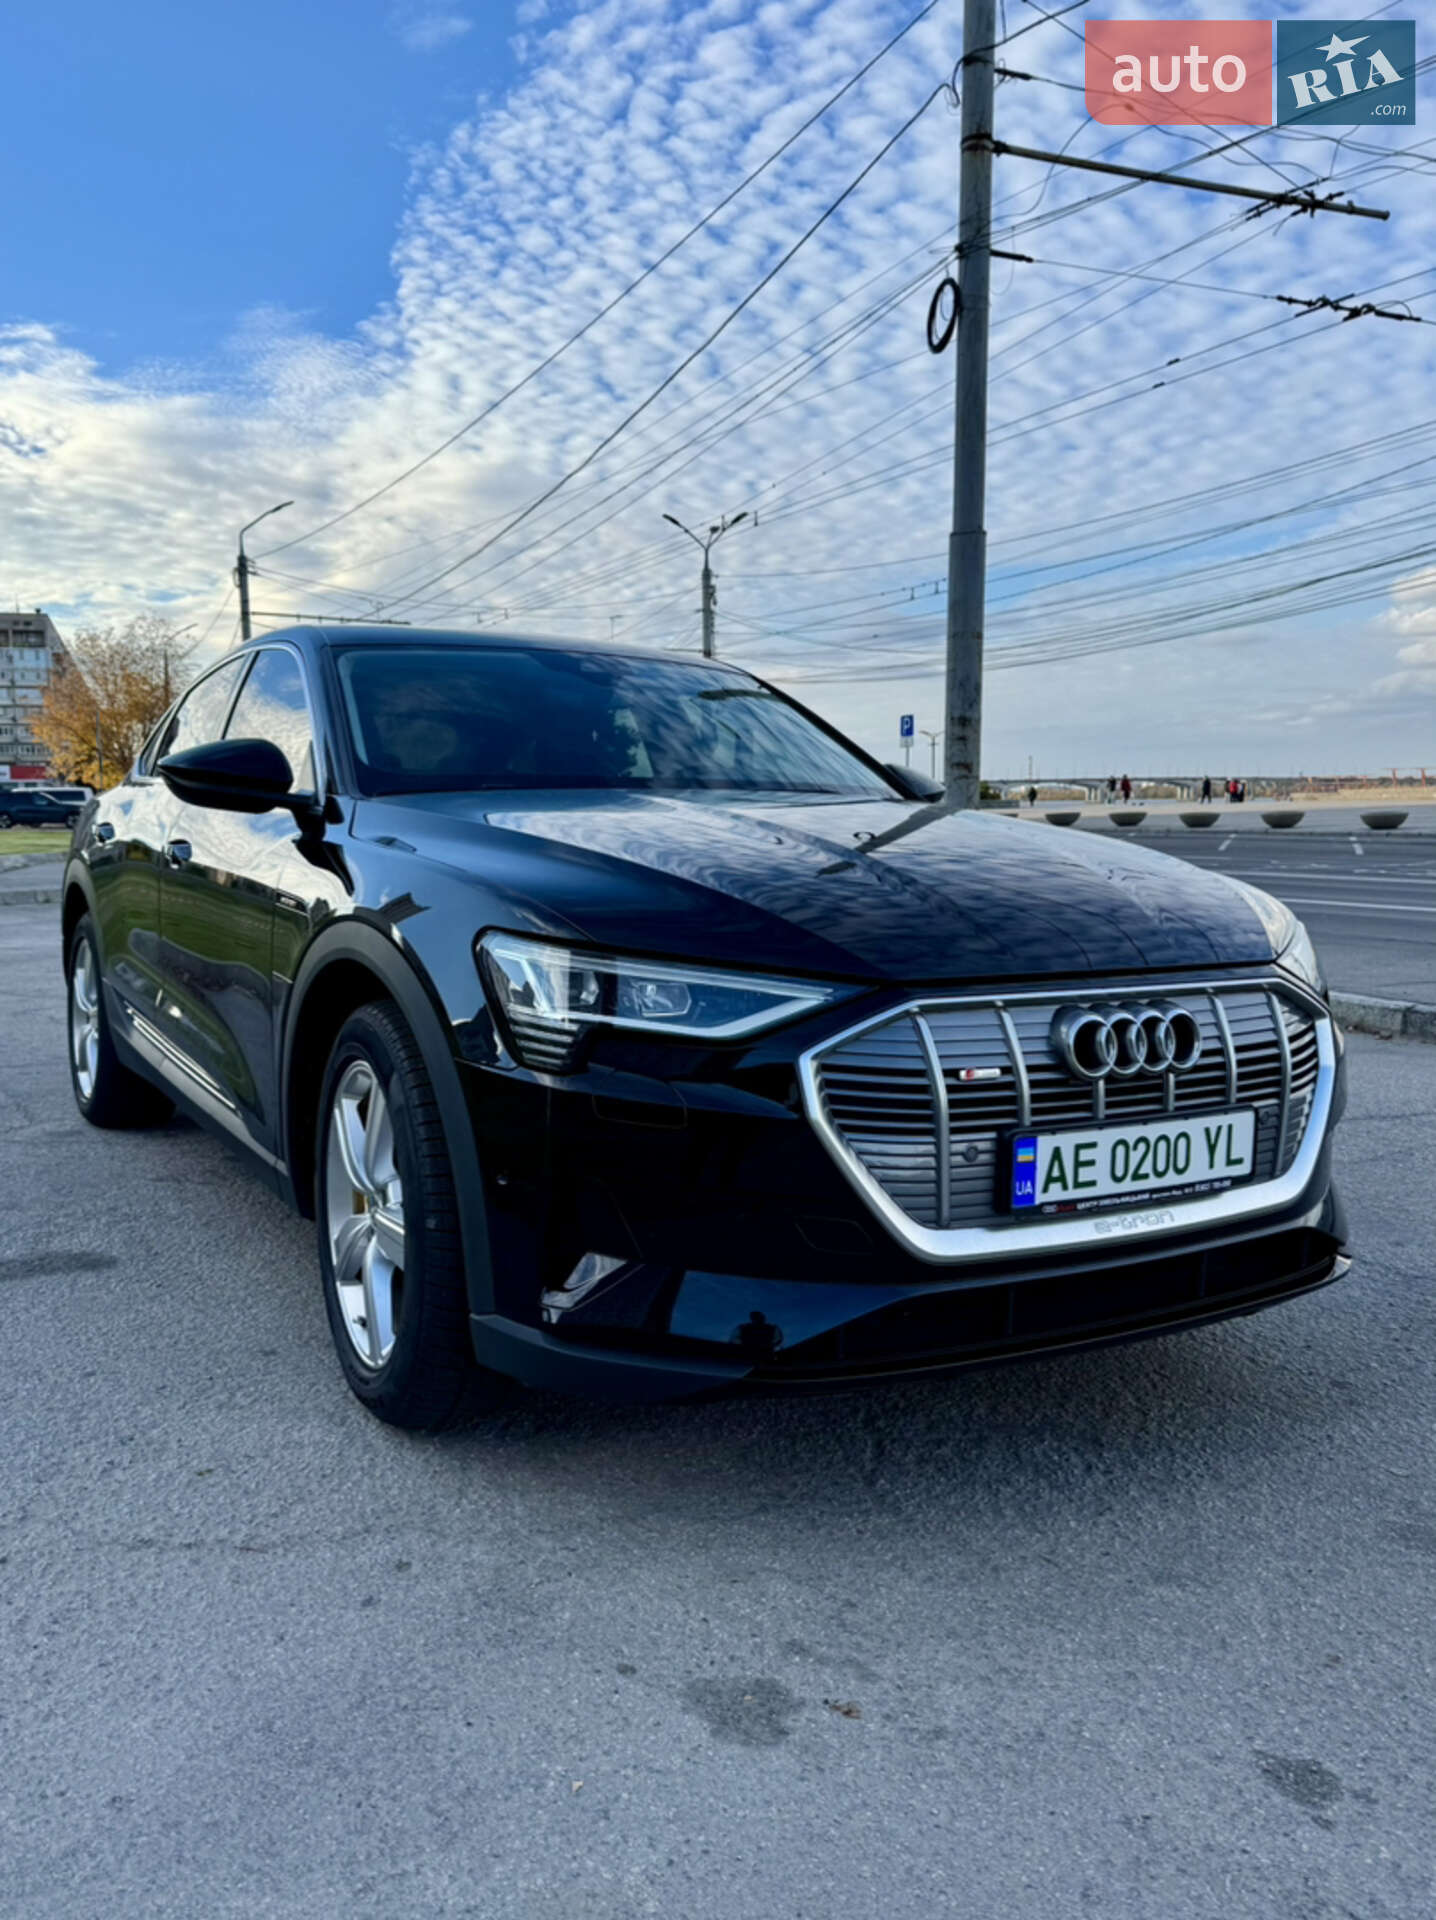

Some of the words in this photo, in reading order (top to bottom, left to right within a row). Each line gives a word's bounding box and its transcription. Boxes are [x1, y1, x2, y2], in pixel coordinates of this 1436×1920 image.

[903, 718, 911, 735] P
[1042, 1141, 1098, 1194] AE
[1110, 1131, 1191, 1184] 0200
[1204, 1123, 1244, 1170] YL
[1016, 1180, 1034, 1196] UA
[1093, 1210, 1175, 1235] e-tron
